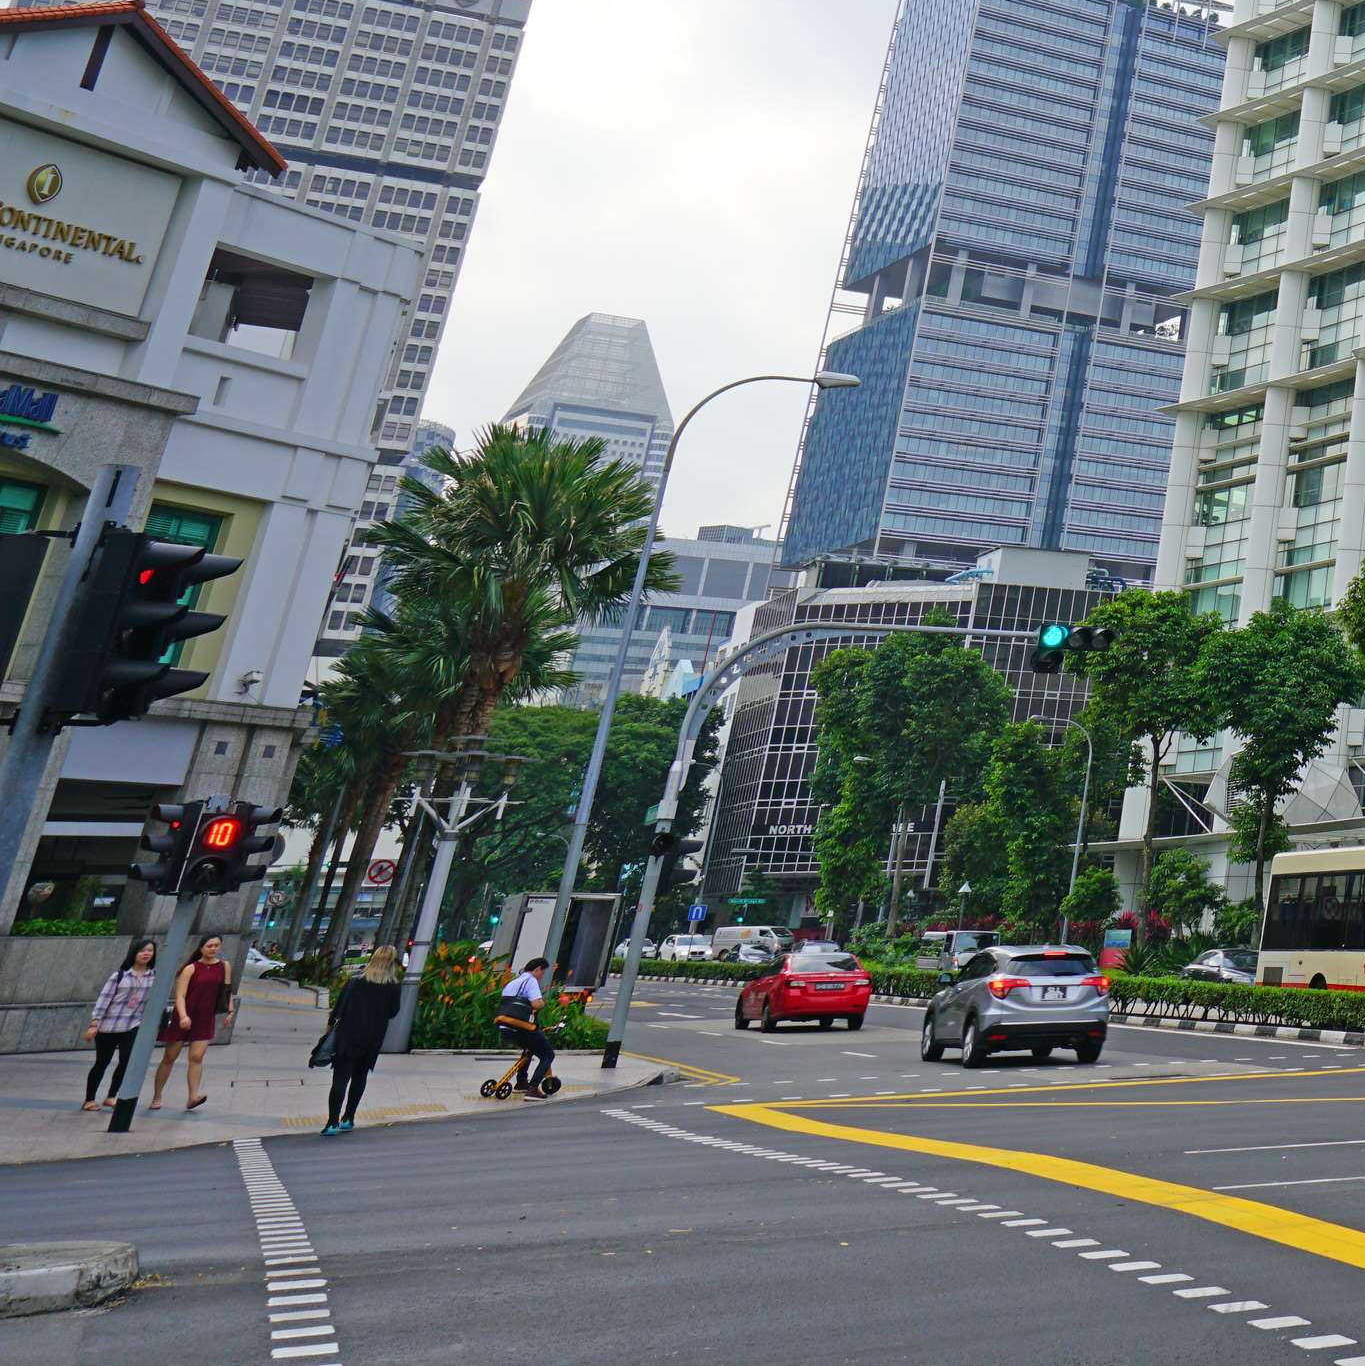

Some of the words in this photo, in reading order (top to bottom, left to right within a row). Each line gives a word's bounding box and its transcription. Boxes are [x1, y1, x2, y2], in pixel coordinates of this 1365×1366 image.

[0, 201, 137, 263] ONTINENTAL
[208, 822, 233, 846] 10
[769, 824, 812, 835] NORTH
